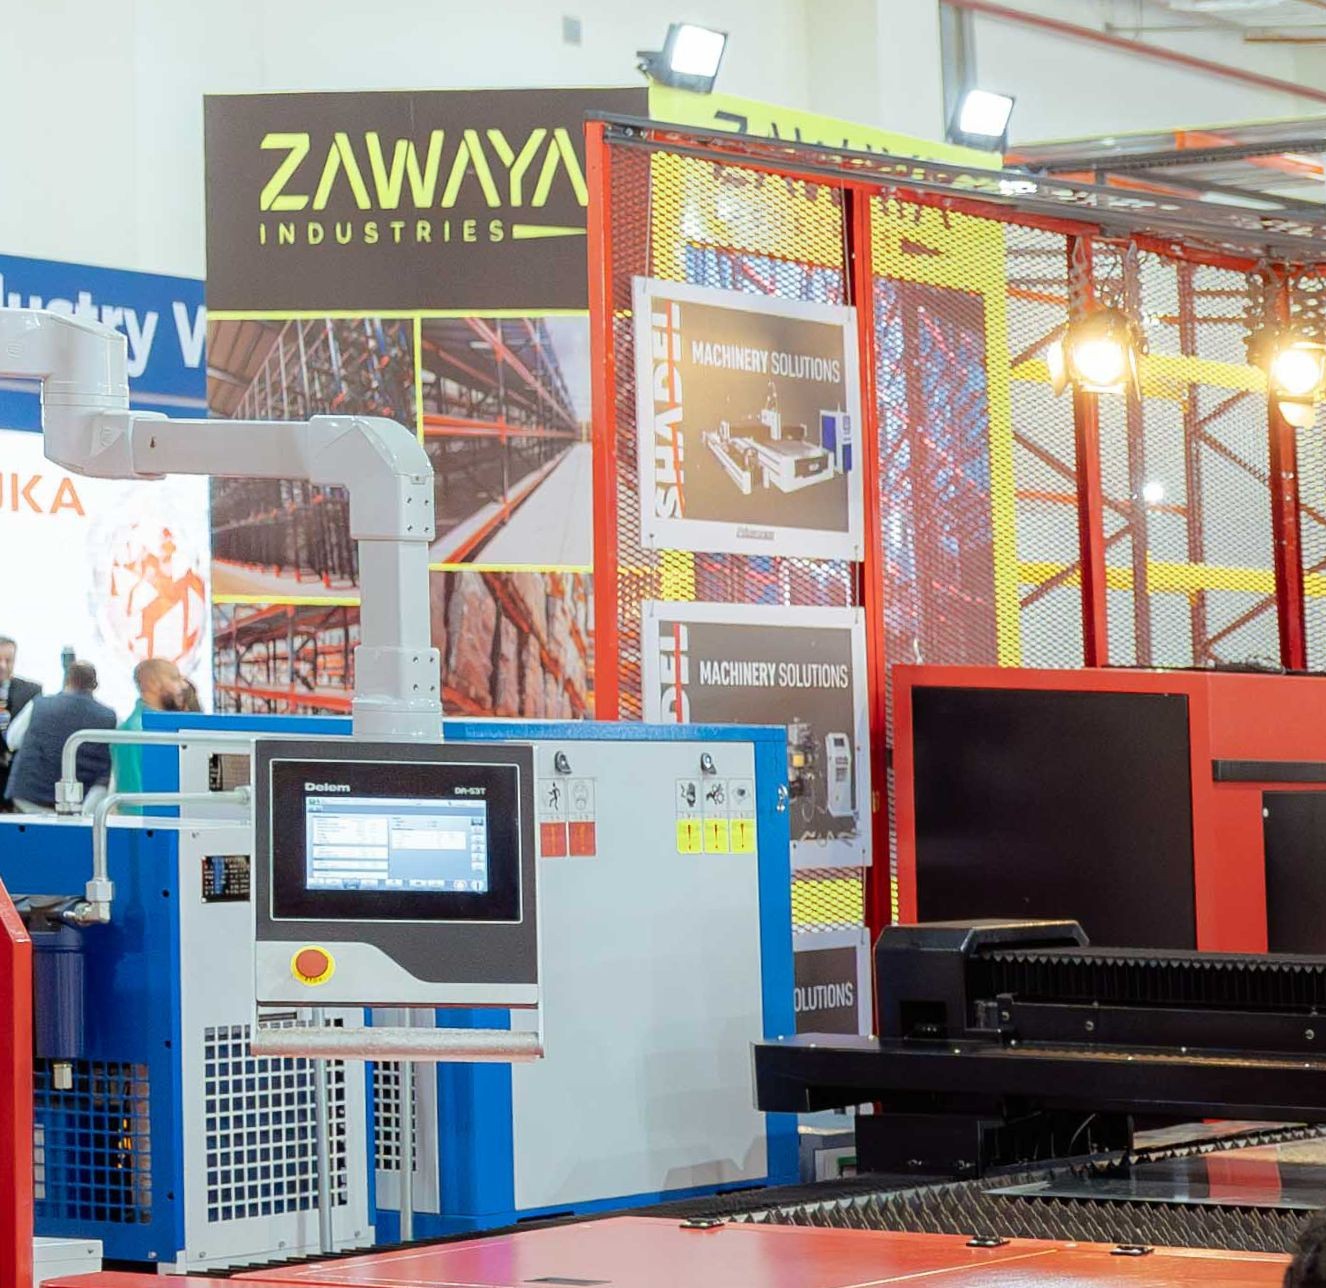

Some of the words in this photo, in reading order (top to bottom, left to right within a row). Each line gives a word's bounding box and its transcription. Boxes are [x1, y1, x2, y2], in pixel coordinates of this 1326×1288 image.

[260, 128, 589, 211] ZAWAYA
[260, 219, 504, 246] INDUSTRIES
[692, 340, 768, 374] MACHINERY
[770, 351, 841, 384] SOLUTIONS
[652, 300, 685, 518] SHADEL
[0, 471, 86, 517] KA
[700, 660, 776, 687] MACHINERY
[778, 662, 849, 689] SOLUTIONS
[304, 782, 350, 793] Delem
